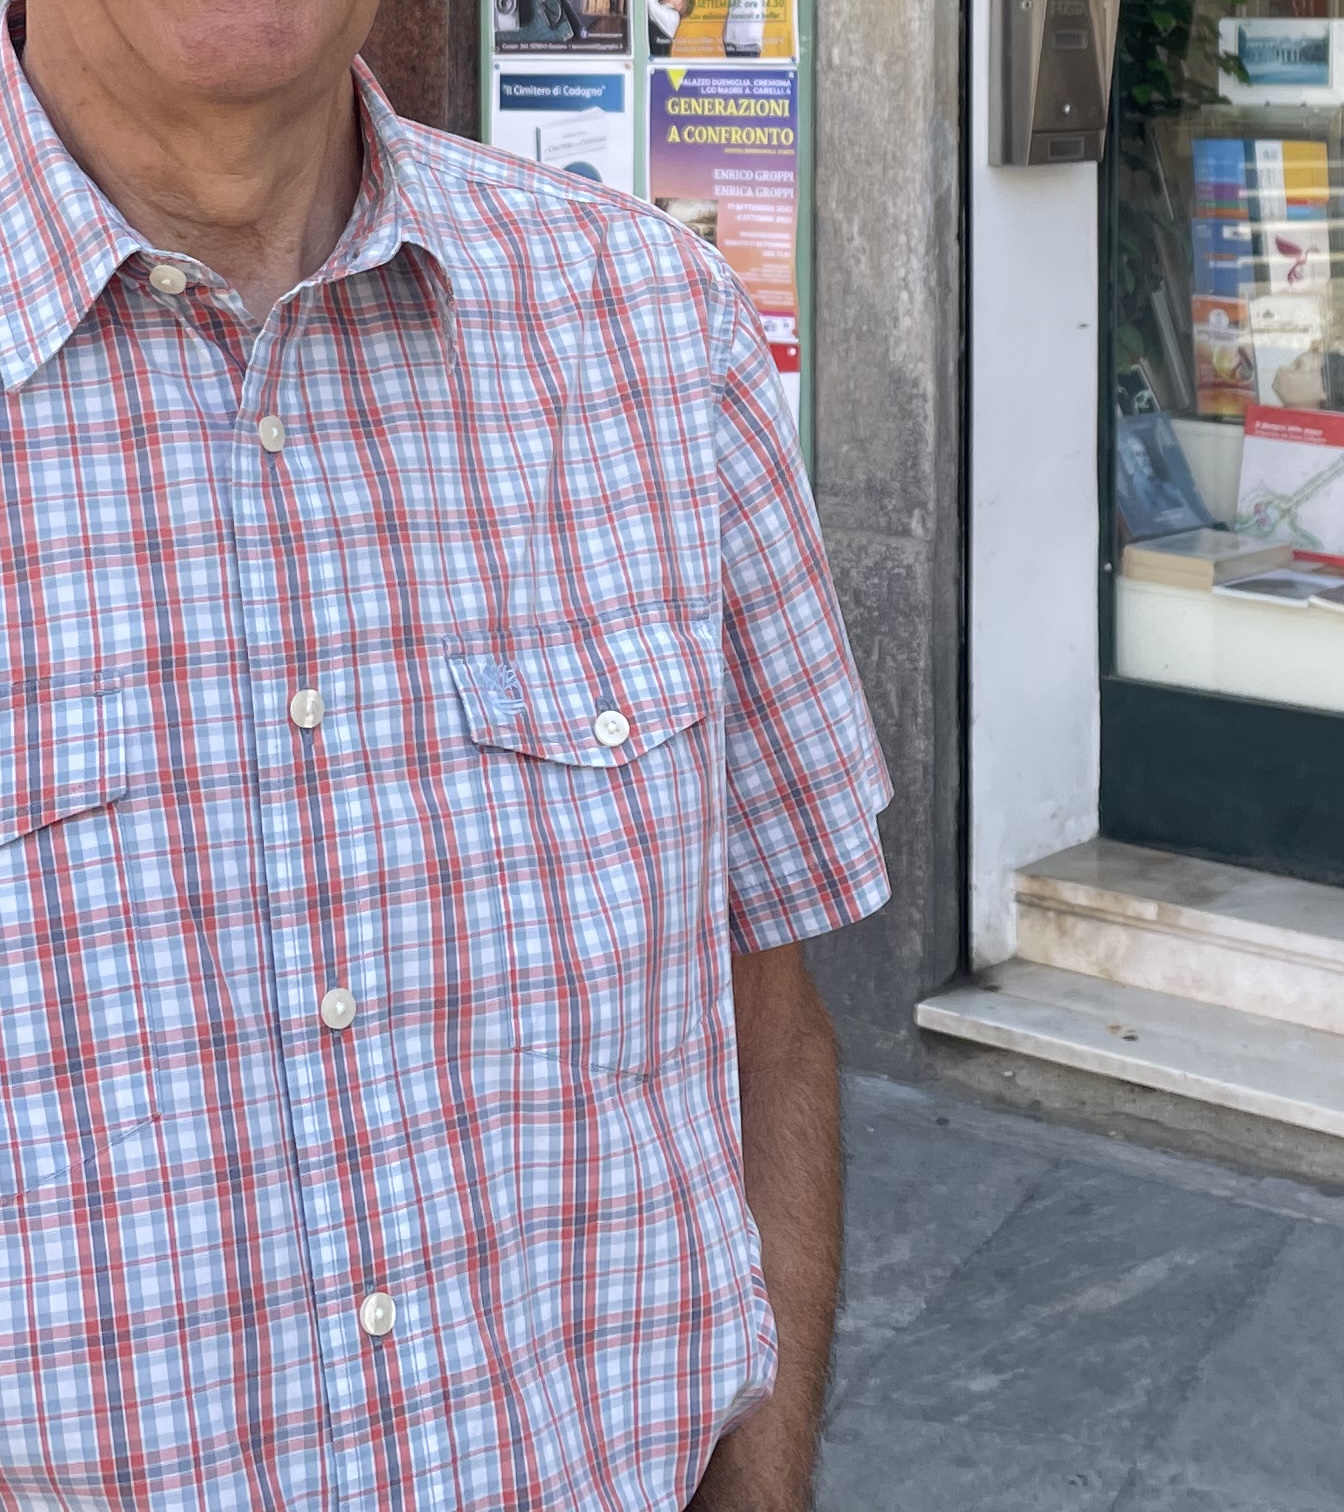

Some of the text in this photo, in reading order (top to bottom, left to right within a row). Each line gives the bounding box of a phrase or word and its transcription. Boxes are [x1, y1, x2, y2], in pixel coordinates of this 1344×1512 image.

[513, 85, 551, 96] Cimitero
[552, 85, 562, 96] di
[666, 97, 791, 117] GENERAZIONI
[667, 125, 795, 146] A CONFRONTO
[714, 168, 794, 182] ENRICO GROPPI
[714, 185, 794, 199] ENRICA GROPPI
